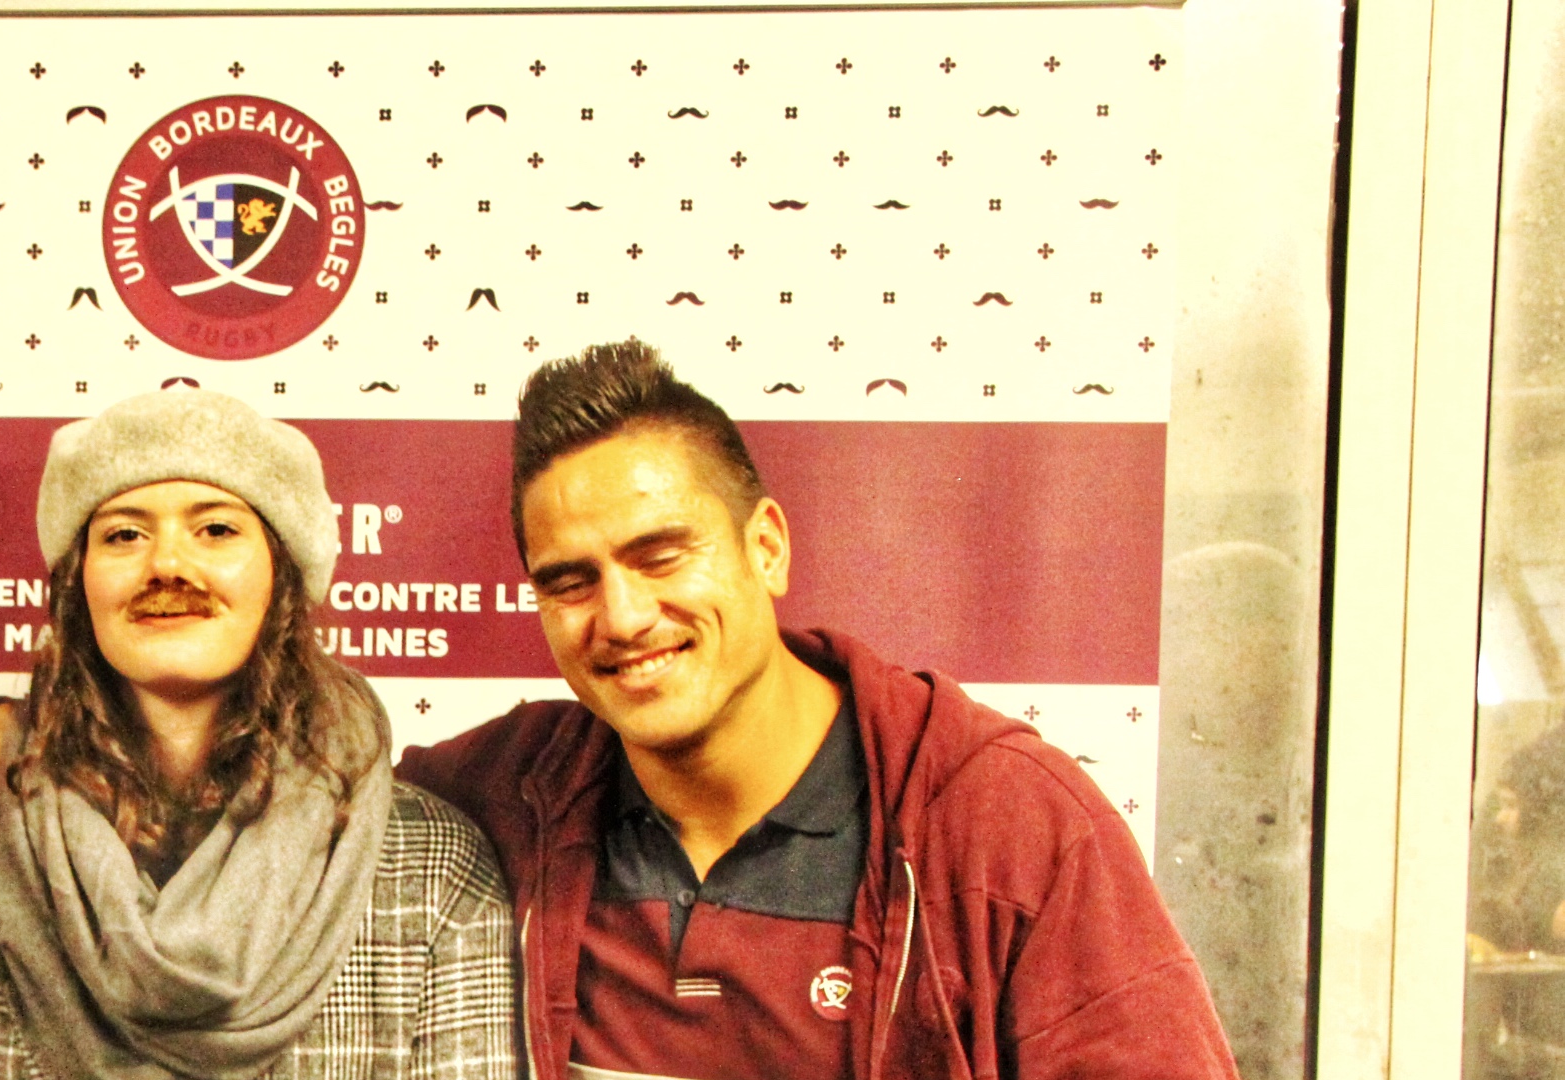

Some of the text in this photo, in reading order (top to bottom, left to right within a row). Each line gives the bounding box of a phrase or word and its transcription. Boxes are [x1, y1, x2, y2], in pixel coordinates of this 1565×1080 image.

[112, 105, 357, 293] UNION BORDEAUX BEGLES
[183, 320, 276, 348] RUGBY
[329, 581, 482, 612] CONTRE
